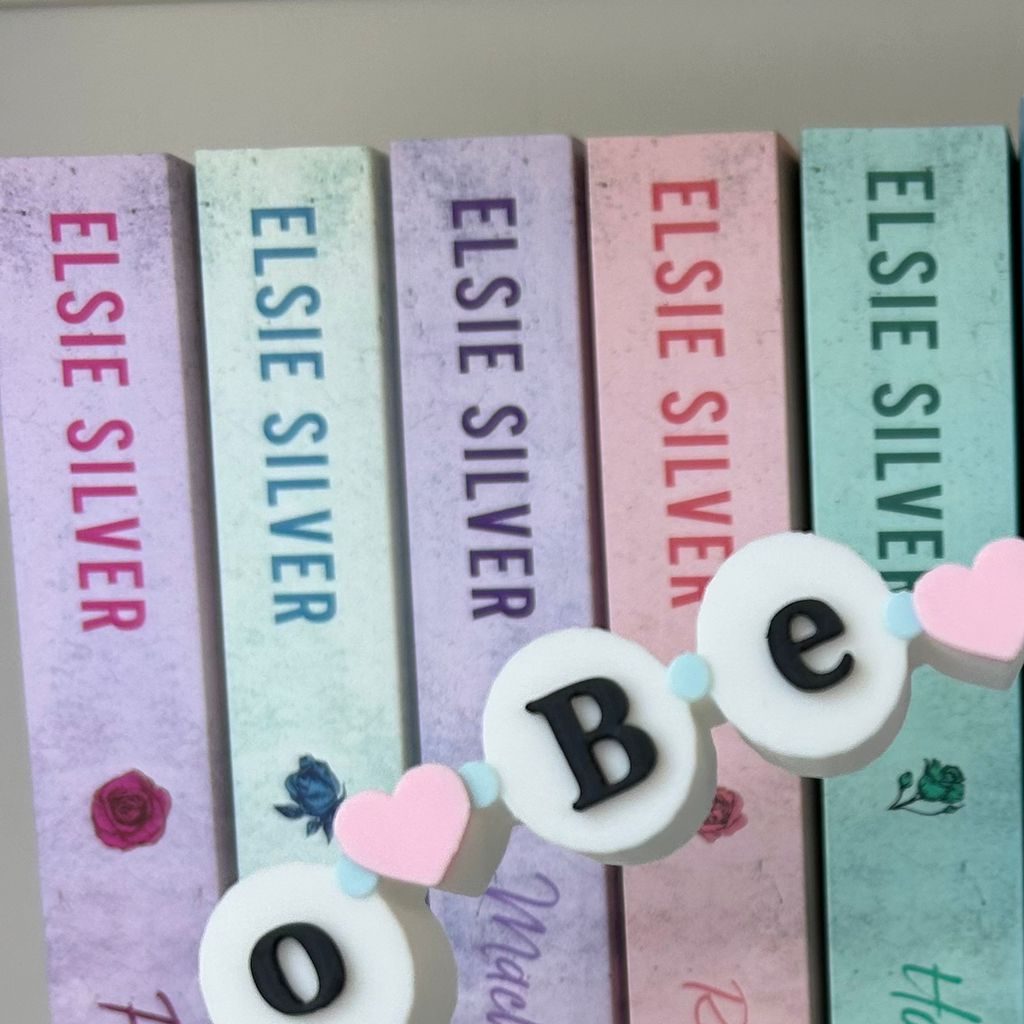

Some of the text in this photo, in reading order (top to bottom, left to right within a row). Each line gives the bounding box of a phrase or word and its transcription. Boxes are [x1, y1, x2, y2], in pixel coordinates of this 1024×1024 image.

[50, 212, 147, 633] ELSIE SILVER
[250, 206, 338, 625] ELSIE SILVER
[451, 197, 536, 620] ELSIE SILVER
[651, 178, 726, 359] ELSIE
[867, 170, 938, 351] ELSIE
